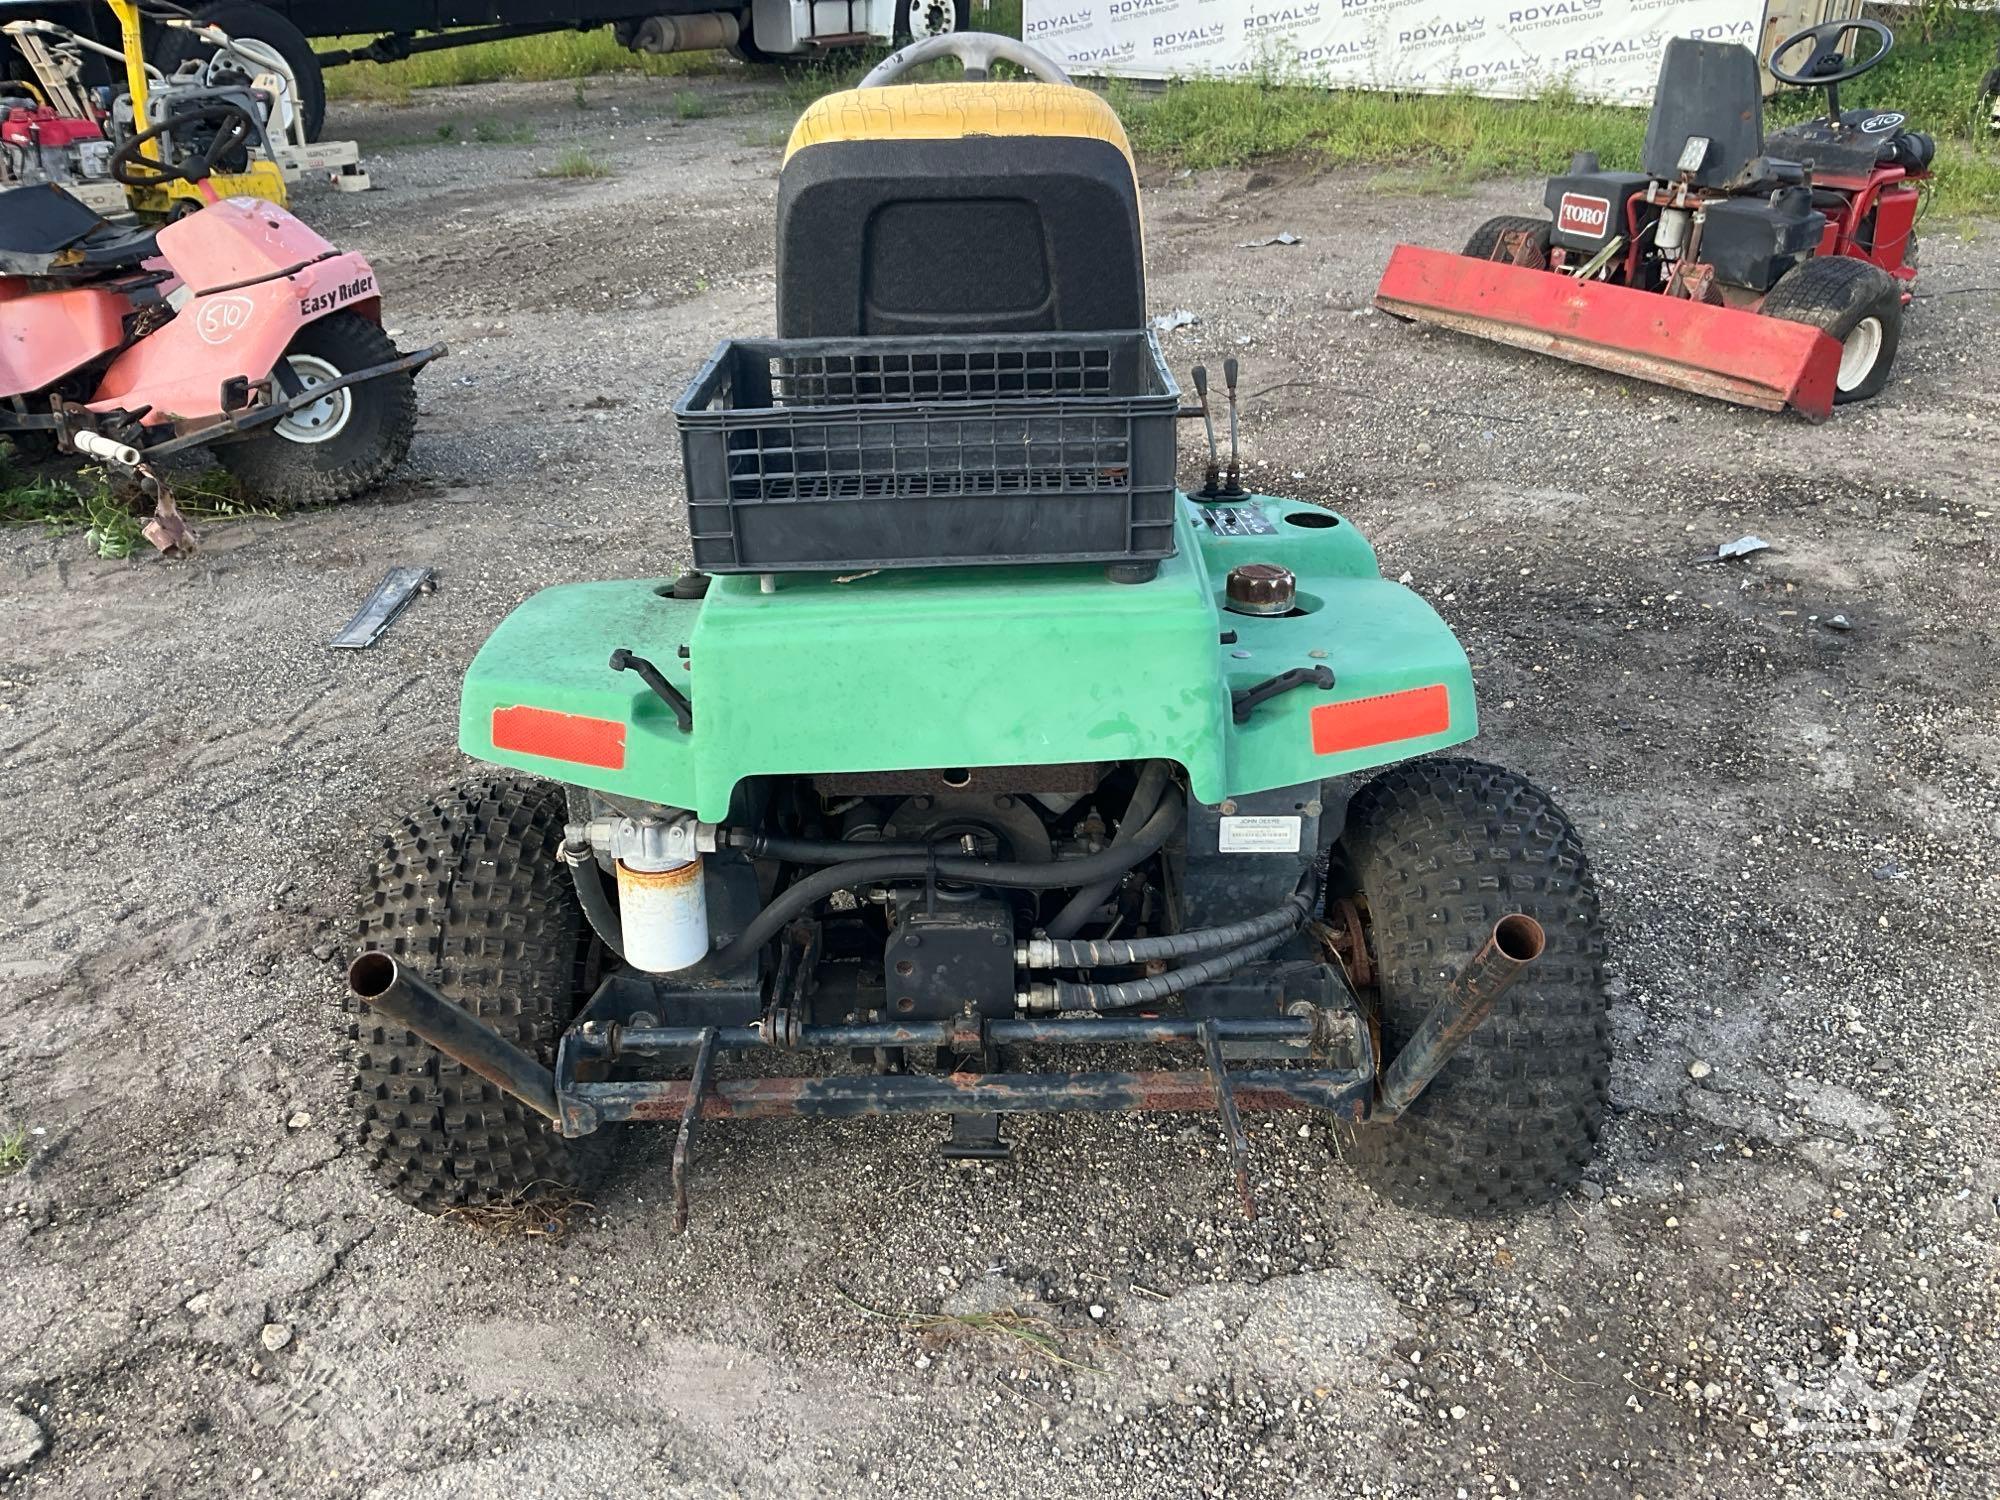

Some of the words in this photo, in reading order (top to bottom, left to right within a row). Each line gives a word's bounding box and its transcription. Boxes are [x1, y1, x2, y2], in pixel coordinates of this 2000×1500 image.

[1111, 10, 1148, 23] AUCTION
[1149, 3, 1179, 15] GROUP
[1243, 8, 1304, 29] ROYAL
[1343, 4, 1387, 18] AUCTION
[1509, 1, 1582, 24] ROYAL
[1026, 14, 1079, 33] ROYAL
[1028, 28, 1064, 41] AUCTION
[1065, 22, 1094, 34] GROUP
[1287, 17, 1321, 29] GROUP
[1399, 21, 1466, 43] ROYAL
[1510, 18, 1560, 34] AUCTION
[1562, 11, 1603, 24] GROUP
[1153, 28, 1209, 47] ROYAL
[1154, 43, 1192, 56] AUCTION
[1194, 36, 1225, 48] GROUP
[1296, 41, 1360, 61] ROYAL
[1565, 39, 1641, 62] ROYAL
[1618, 49, 1662, 63] GROUP
[1450, 58, 1520, 80] ROYAL
[1865, 116, 1898, 130] 510
[1563, 204, 1603, 225] TORO
[301, 290, 337, 316] Easy
[338, 275, 373, 302] Rider
[205, 304, 240, 332] 510
